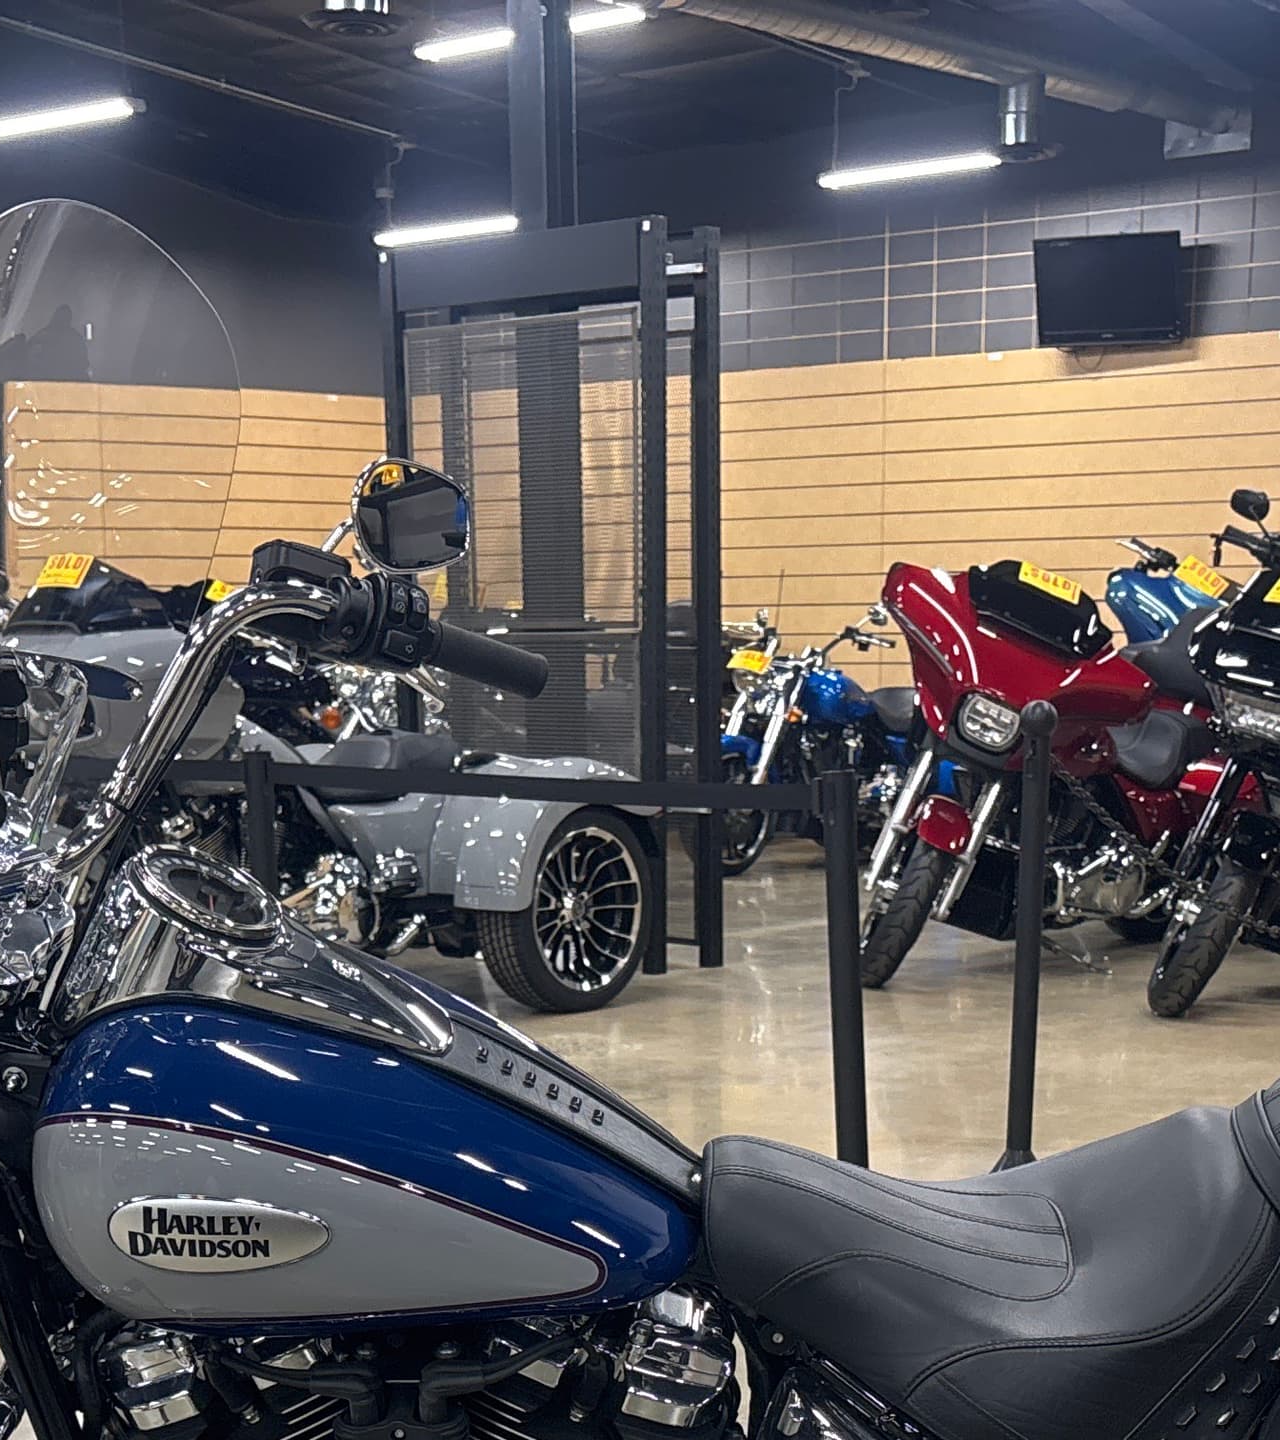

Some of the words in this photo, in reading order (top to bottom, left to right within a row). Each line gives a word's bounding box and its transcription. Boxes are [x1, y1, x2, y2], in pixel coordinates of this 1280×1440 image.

[48, 555, 84, 570] SOLD
[1188, 560, 1221, 588] SOLD
[1030, 566, 1071, 591] SOLD
[128, 1230, 270, 1258] DAVIDSON
